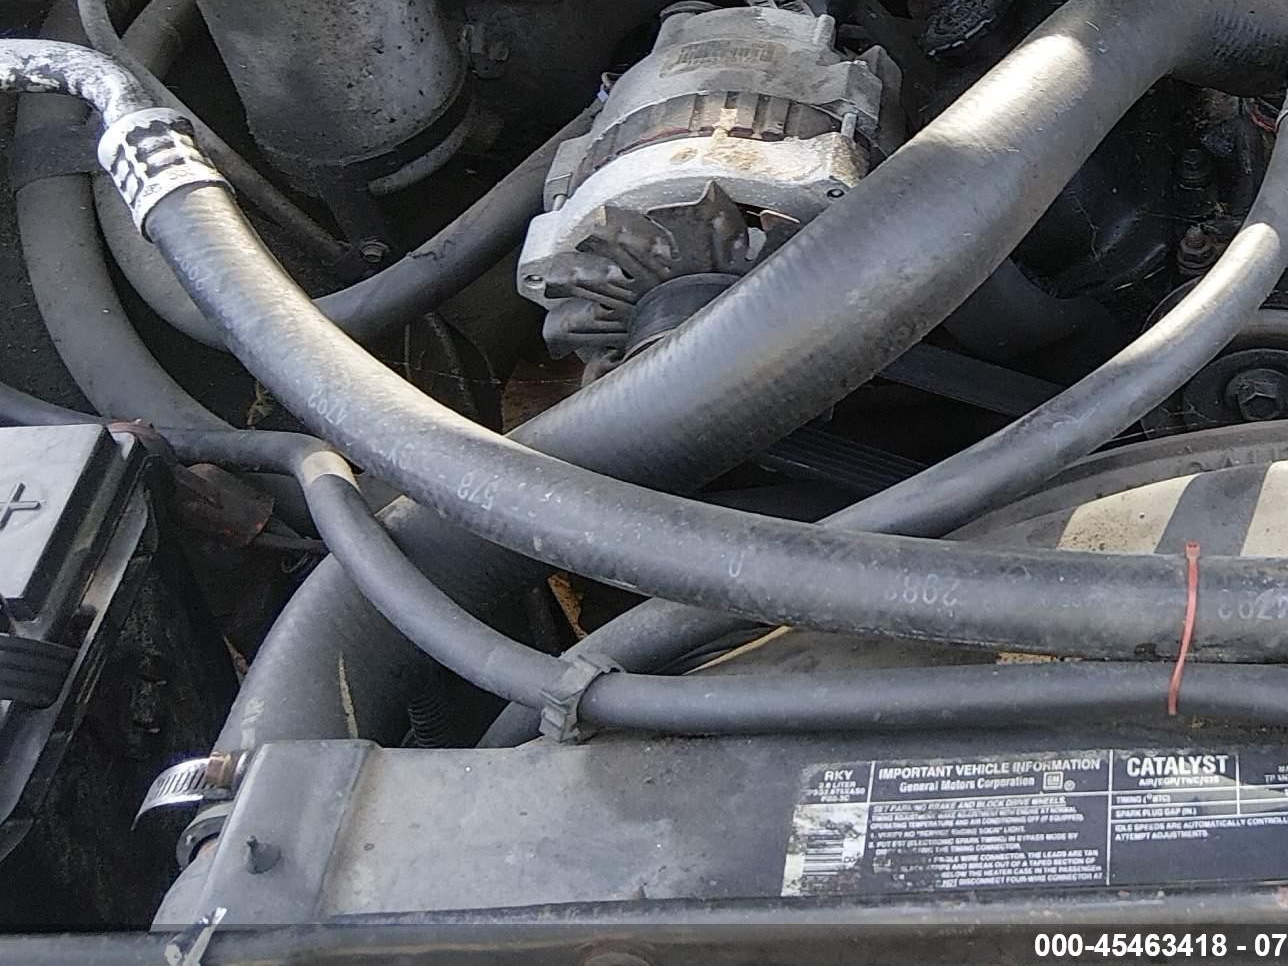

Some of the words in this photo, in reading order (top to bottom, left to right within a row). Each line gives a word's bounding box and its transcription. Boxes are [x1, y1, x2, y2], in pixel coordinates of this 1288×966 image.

[879, 765, 954, 780] IMPORTANT
[955, 761, 1010, 776] VEHICLE
[1013, 758, 1100, 773] INFORMATION
[1127, 755, 1229, 777] CATALYST
[899, 781, 939, 793] General
[941, 779, 976, 791] Motors
[977, 776, 1035, 790] Corporation
[1115, 809, 1141, 818] SPARK
[1142, 808, 1163, 817] PLUG
[1164, 807, 1181, 816] GAP
[1134, 822, 1166, 831] SPEEDS
[1166, 821, 1182, 830] ARE
[1183, 818, 1246, 829] AUTOMATICALLY
[1115, 832, 1151, 842] ATTEMPT
